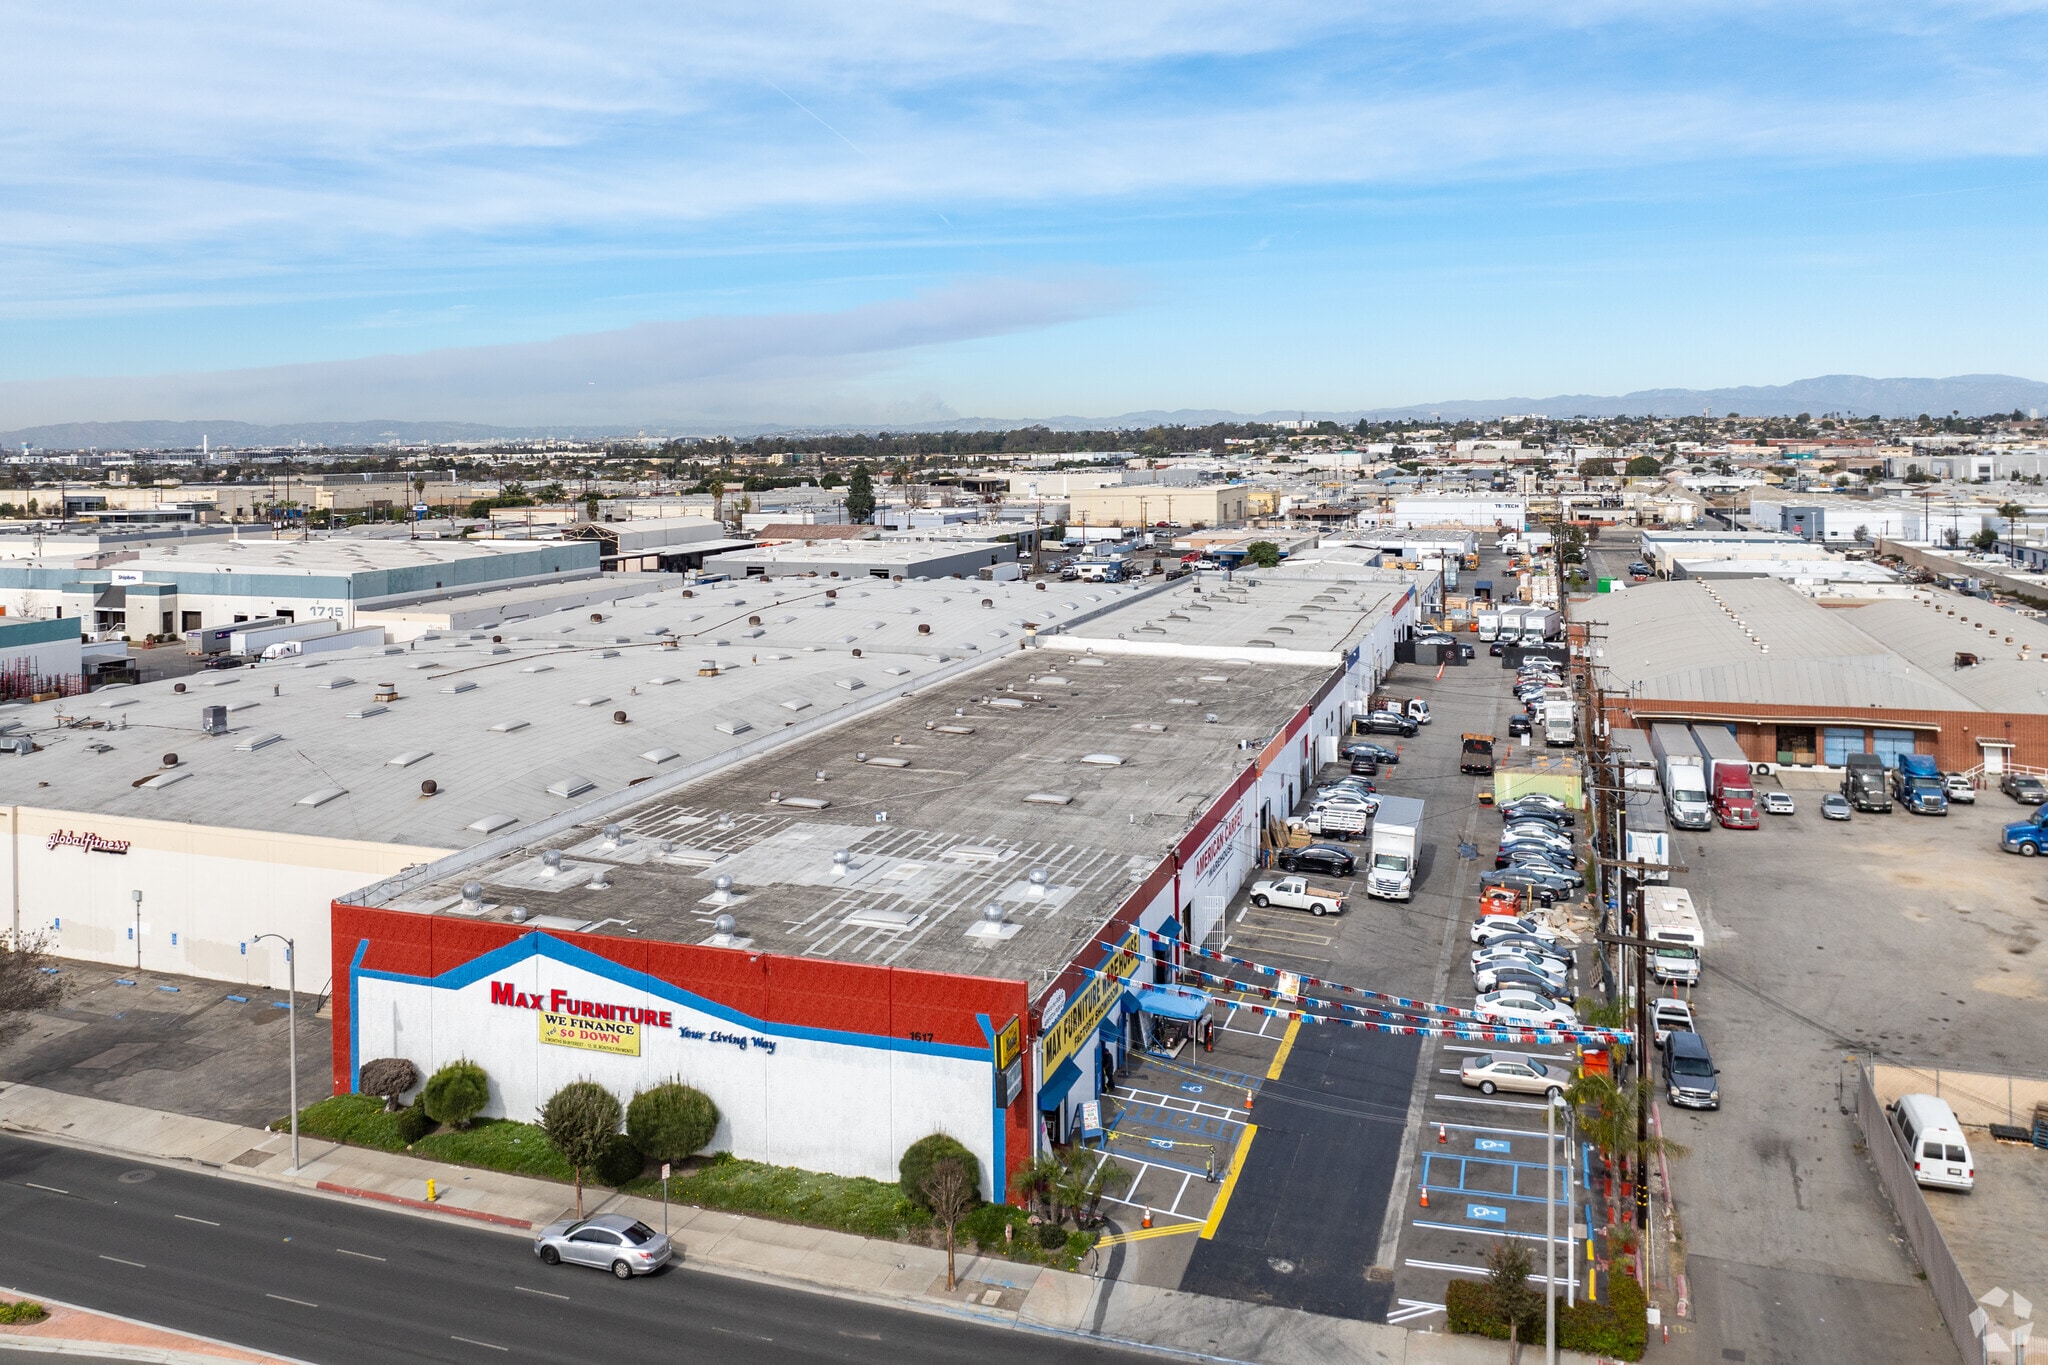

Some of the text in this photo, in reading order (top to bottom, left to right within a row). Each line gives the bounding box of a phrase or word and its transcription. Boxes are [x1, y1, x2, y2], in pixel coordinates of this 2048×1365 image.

[310, 606, 343, 616] 1715
[46, 829, 130, 854] globalfitness
[545, 1014, 635, 1035] WE FINANCE
[1045, 1026, 1061, 1067] MAX
[1063, 978, 1100, 1044] FURNITURE
[1074, 984, 1119, 1048] FACTORY SHOWROOM
[580, 1030, 620, 1044] DOWN
[679, 1026, 776, 1054] Your Living Way
[910, 1031, 933, 1043] 1617
